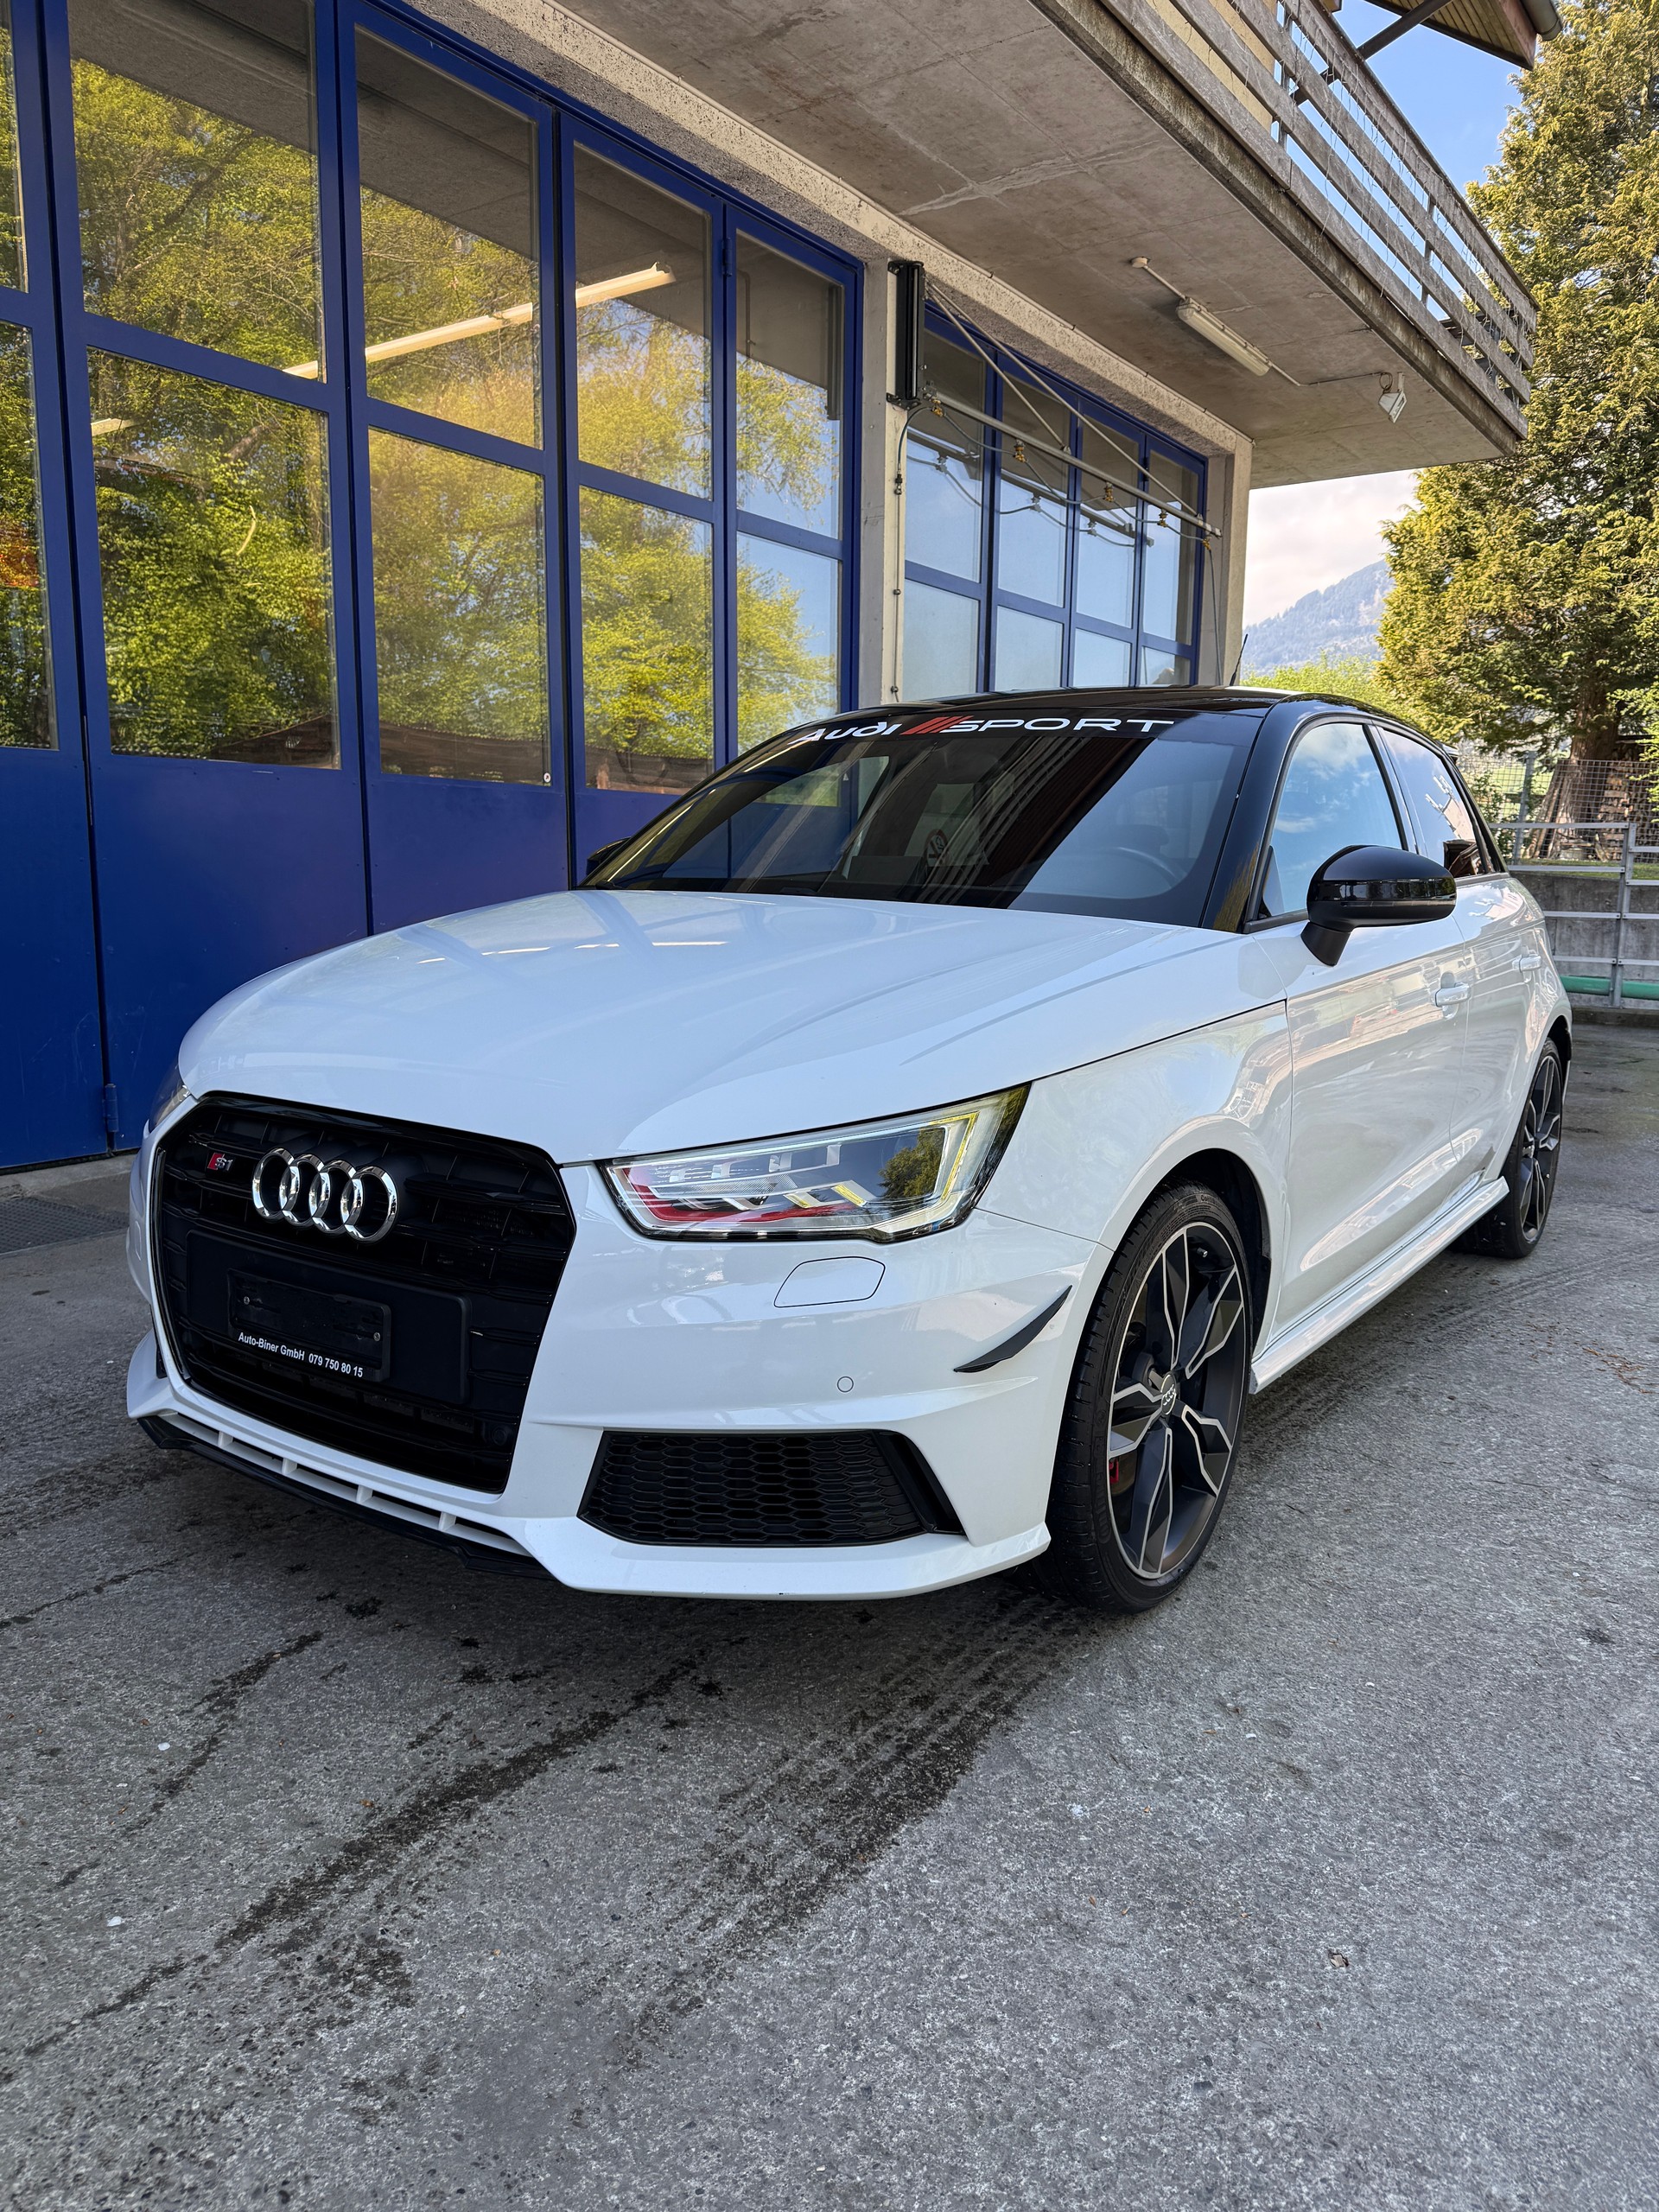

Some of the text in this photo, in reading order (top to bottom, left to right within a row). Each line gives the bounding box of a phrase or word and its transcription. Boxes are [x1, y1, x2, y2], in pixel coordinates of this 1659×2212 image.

[938, 717, 1174, 734] SPORT
[214, 1156, 234, 1172] S1
[238, 1332, 364, 1378] Auto-Biner GmbH 079 750 80 15
